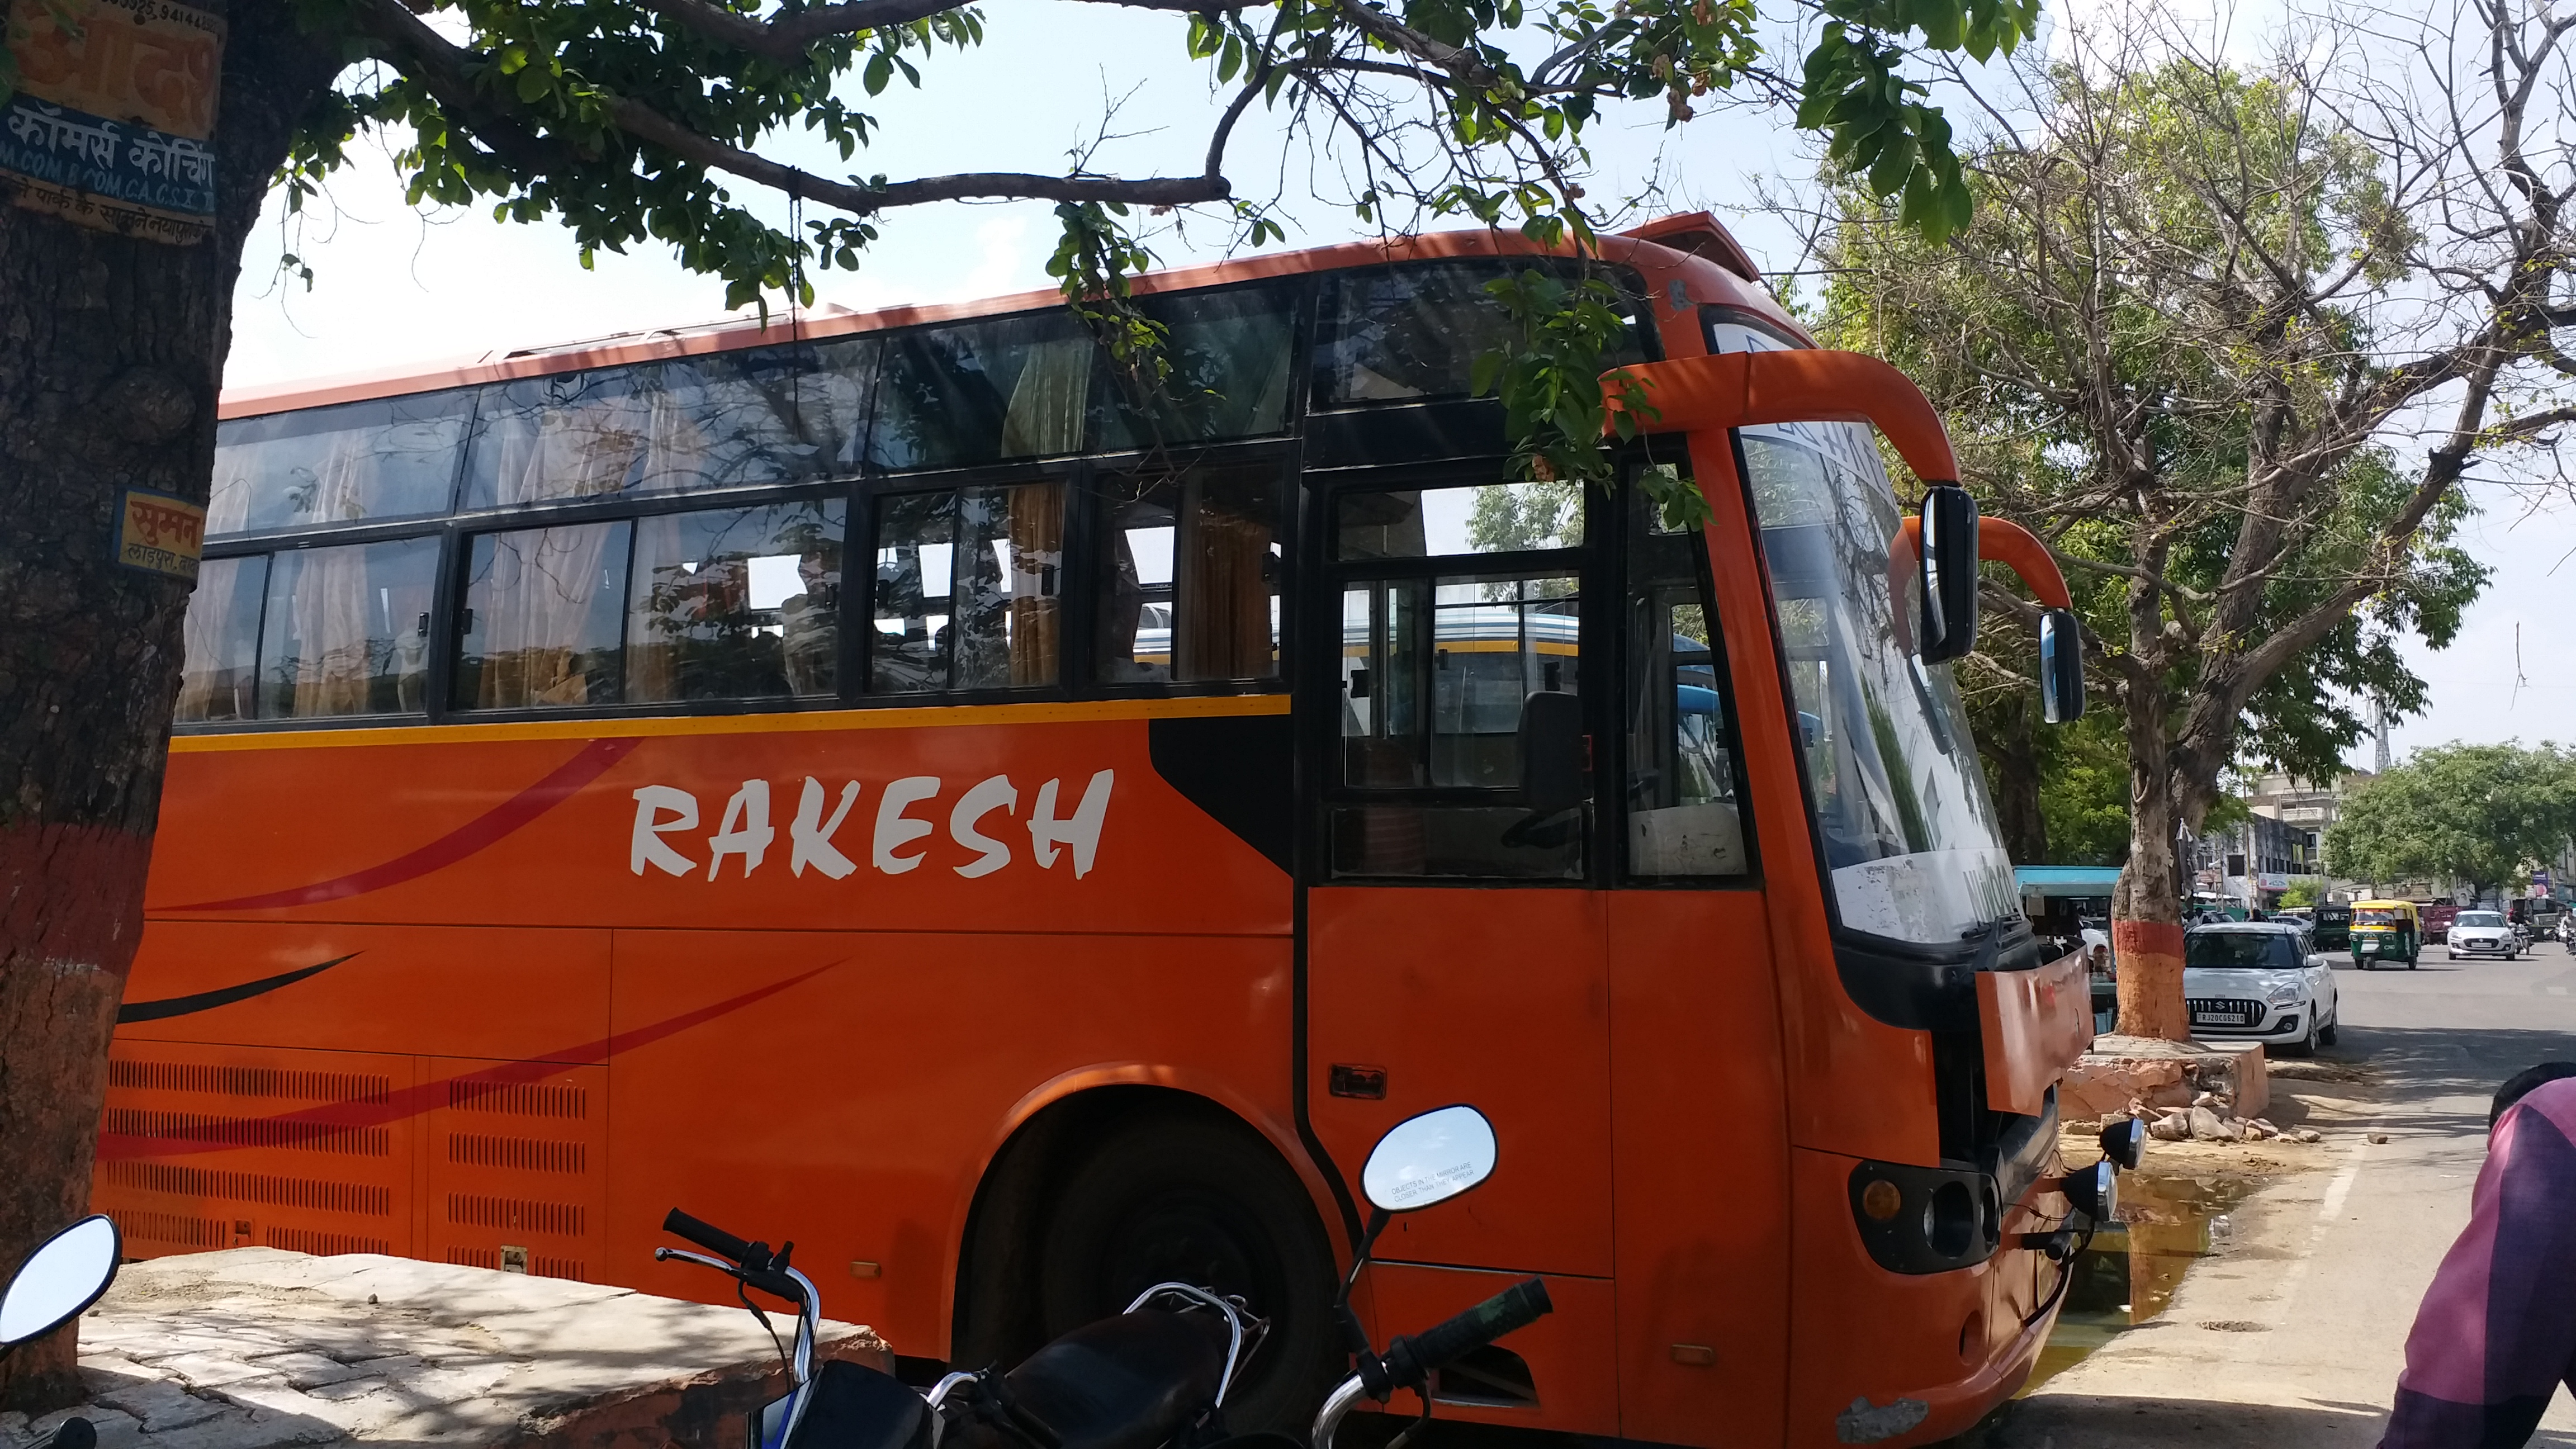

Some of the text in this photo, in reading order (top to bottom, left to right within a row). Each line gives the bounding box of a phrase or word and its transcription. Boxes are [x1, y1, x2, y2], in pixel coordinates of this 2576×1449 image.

[7, 101, 122, 169] कॉमर्स
[34, 188, 73, 209] पार्क
[130, 500, 201, 548] सुमन
[630, 768, 1115, 882] RAKESH
[1391, 1181, 1417, 1195] OBJECTS
[1437, 1166, 1460, 1178] MIRROR
[1460, 1162, 1471, 1171] ARE
[1394, 1169, 1475, 1202] CLOSER THAN THEY APPEAR
